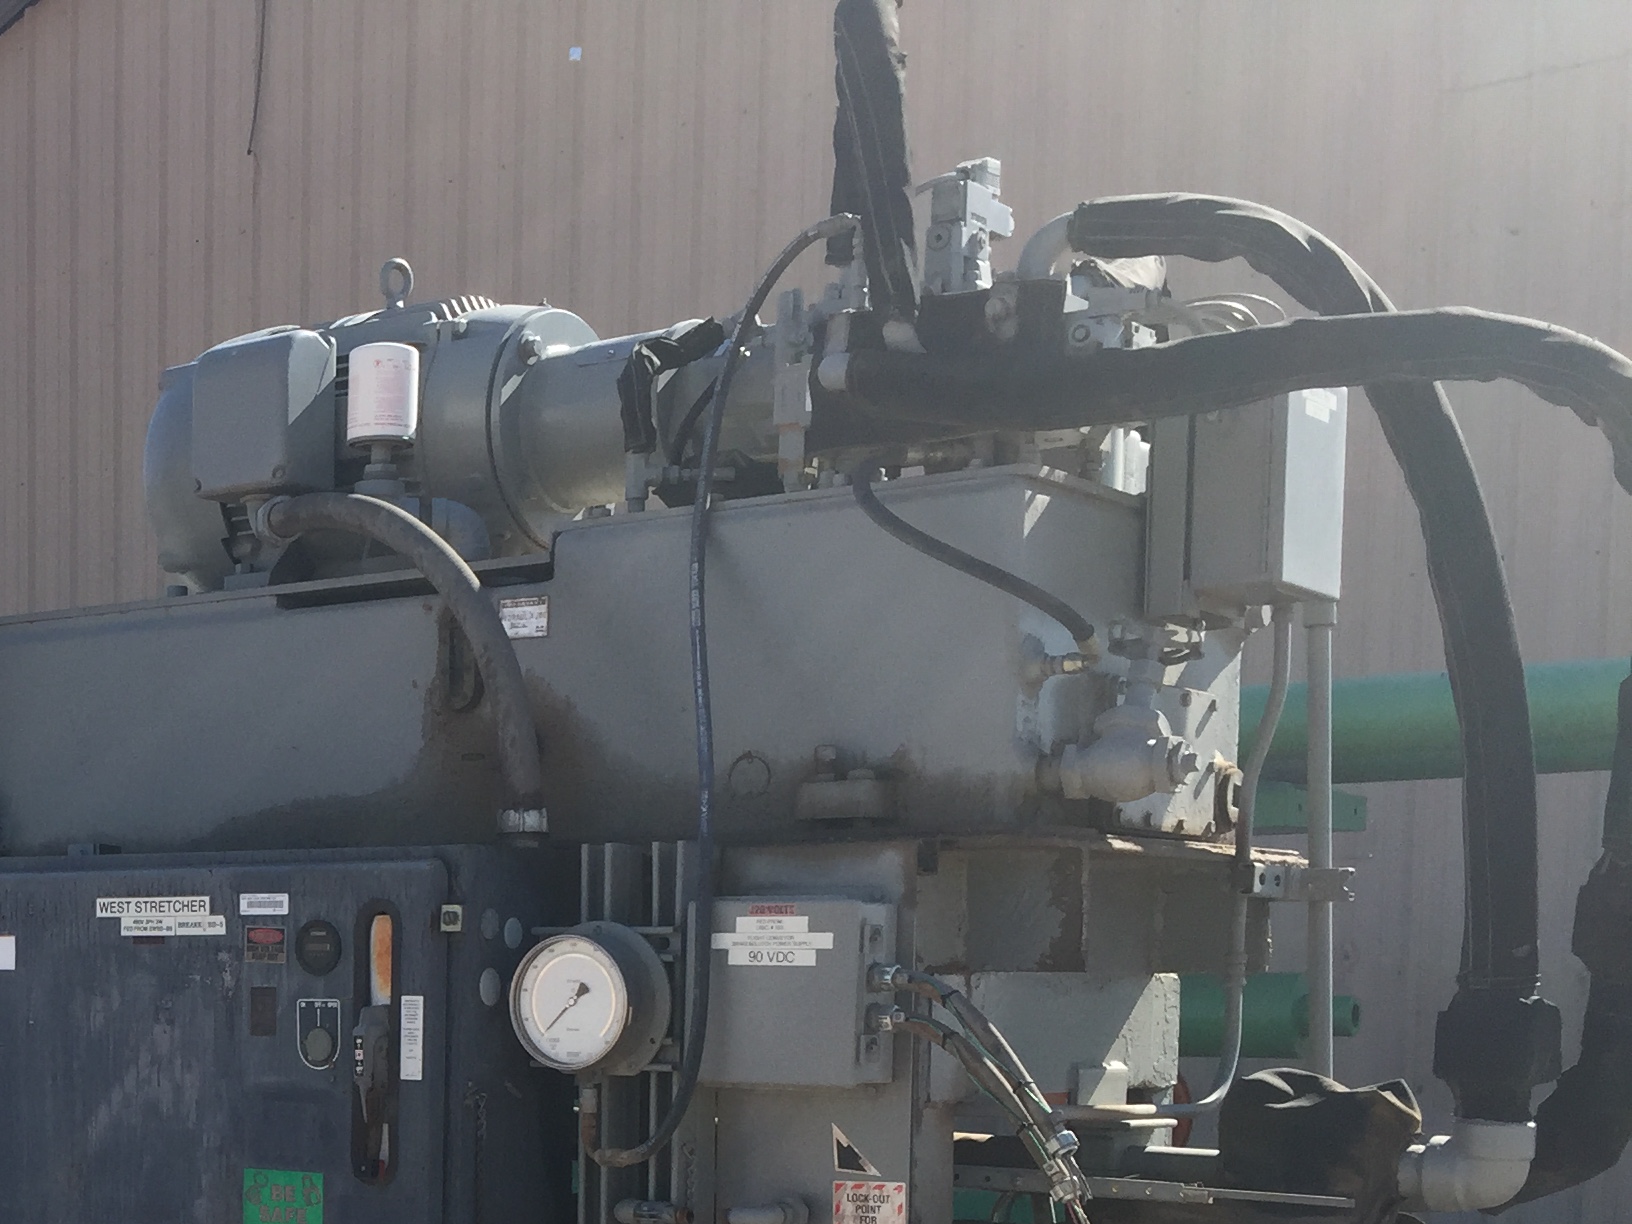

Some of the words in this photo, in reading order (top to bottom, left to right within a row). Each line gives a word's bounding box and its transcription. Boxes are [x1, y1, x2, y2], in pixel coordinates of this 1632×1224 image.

[98, 901, 132, 914] WEST
[134, 900, 207, 913] STRETCHER
[748, 950, 764, 963] 90
[766, 950, 796, 963] VDC
[271, 1184, 297, 1203] BE
[846, 1193, 891, 1204] LOCK-OUT
[855, 1205, 882, 1215] POINT
